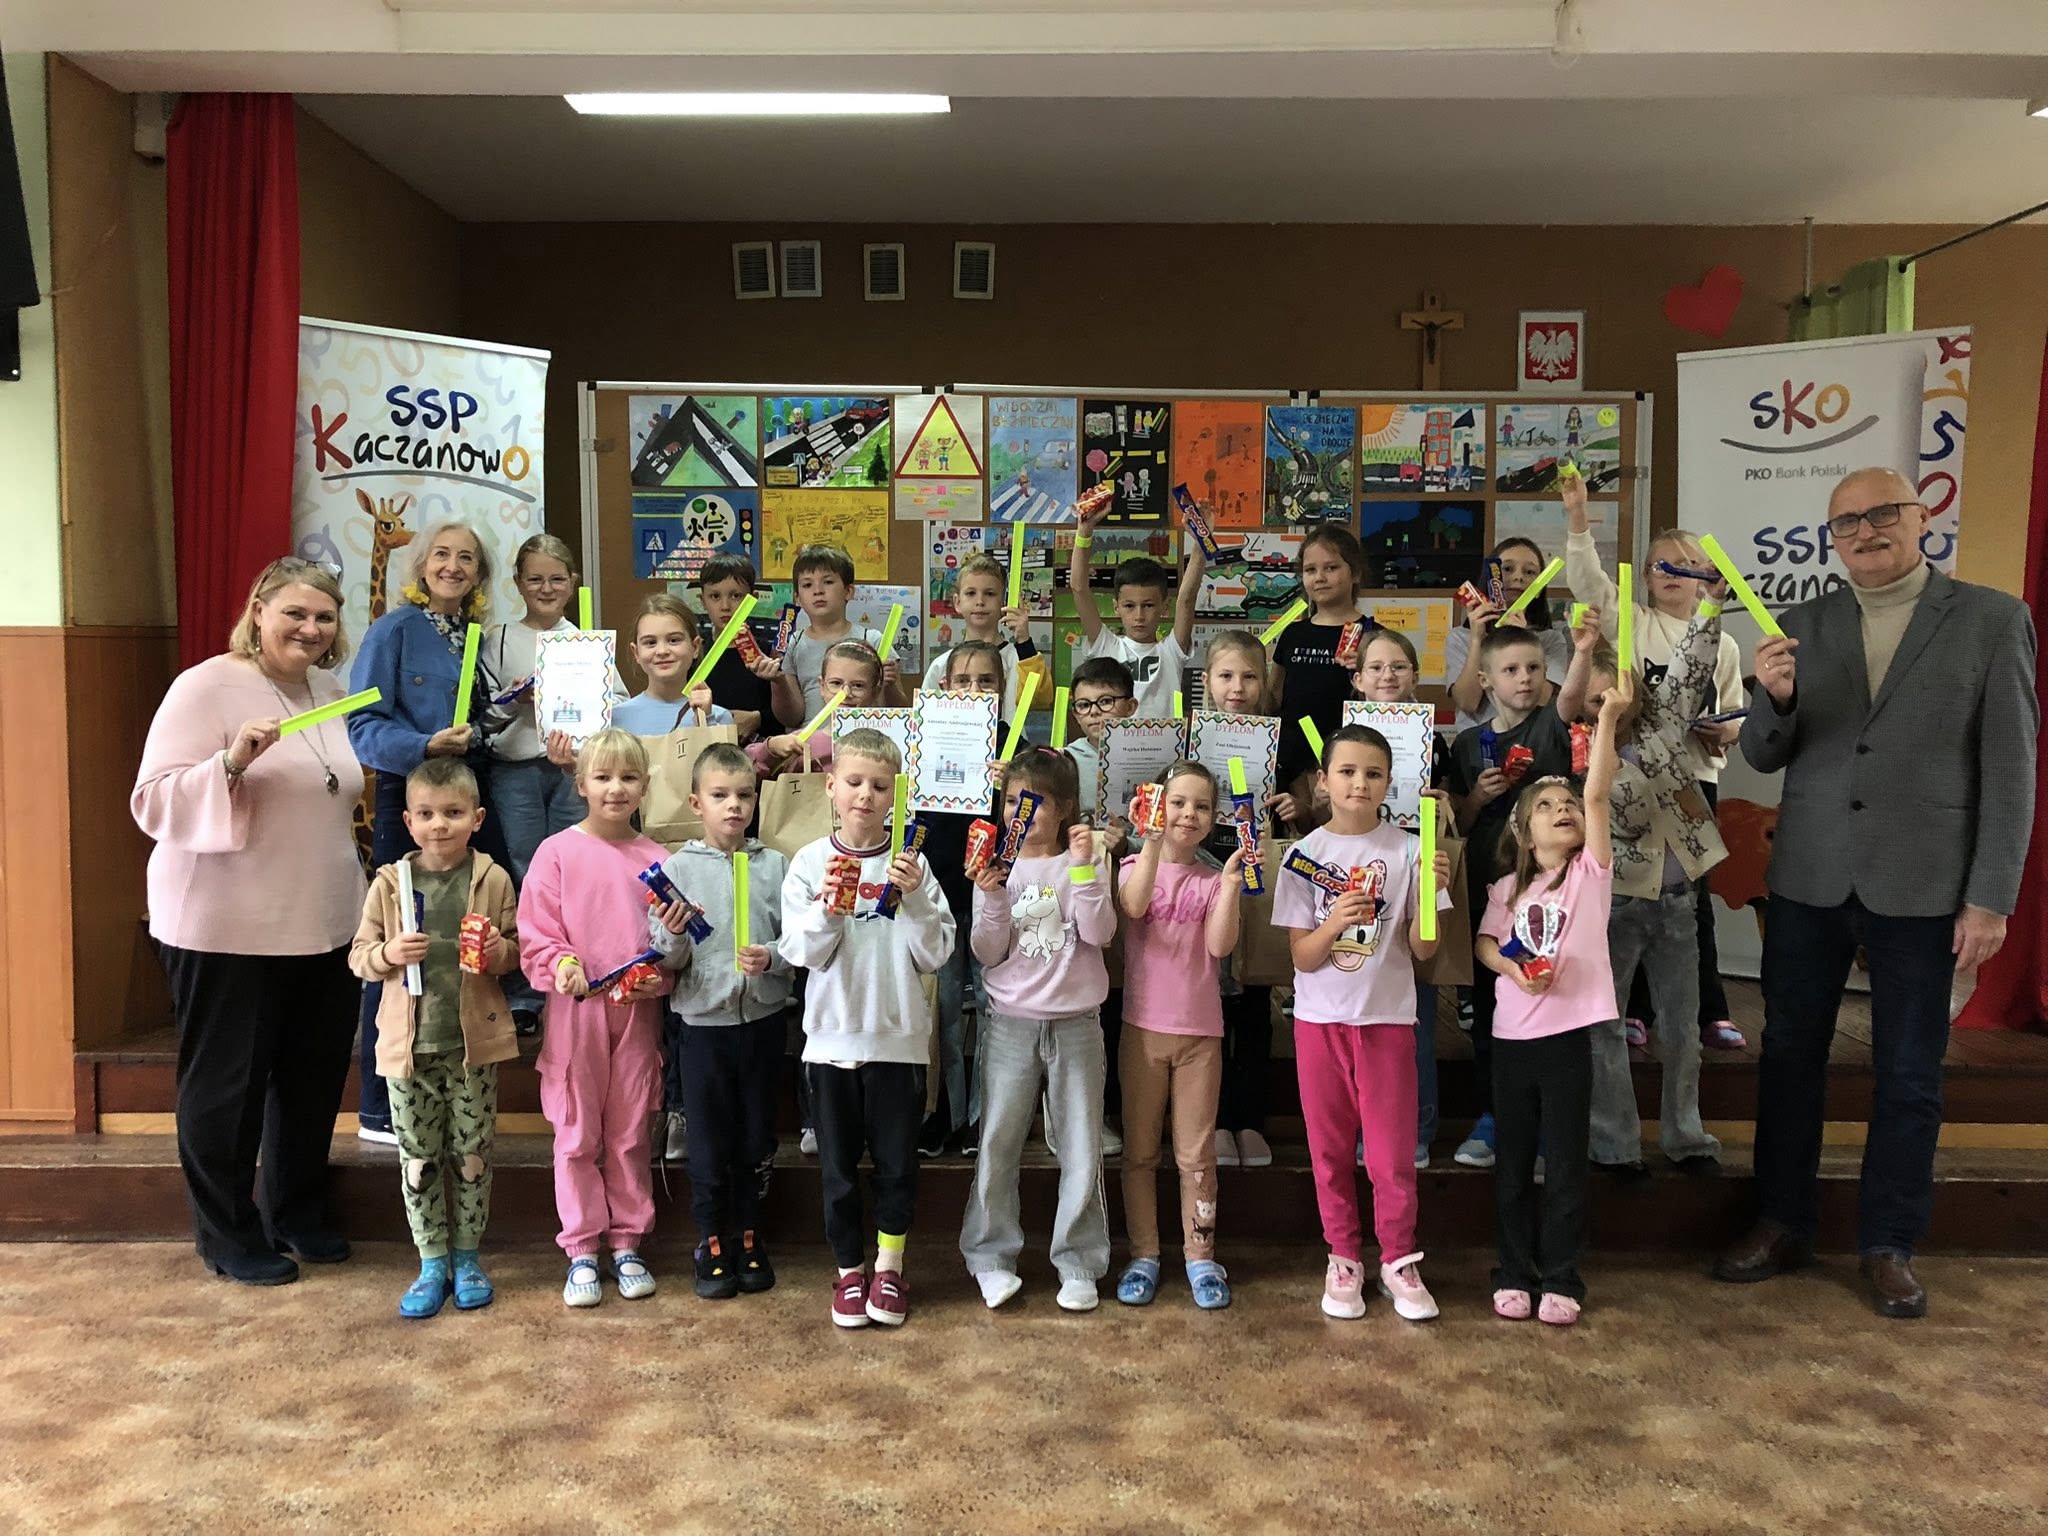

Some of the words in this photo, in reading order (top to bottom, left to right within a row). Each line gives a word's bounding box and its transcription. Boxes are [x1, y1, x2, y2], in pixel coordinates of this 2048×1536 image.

[386, 384, 479, 433] SSP
[1321, 426, 1336, 435] NA
[312, 403, 530, 481] Kaczanowo
[1745, 467, 1772, 480] PKO
[1776, 465, 1806, 479] Bank
[1810, 463, 1847, 477] Polski
[936, 700, 976, 710] DYPLOM
[853, 719, 893, 728] DYPLOM
[1368, 714, 1409, 724] DYPLOM
[1123, 728, 1164, 737] DYPLOM
[1215, 724, 1256, 736] DYPLOM
[1292, 857, 1317, 875] MEGA
